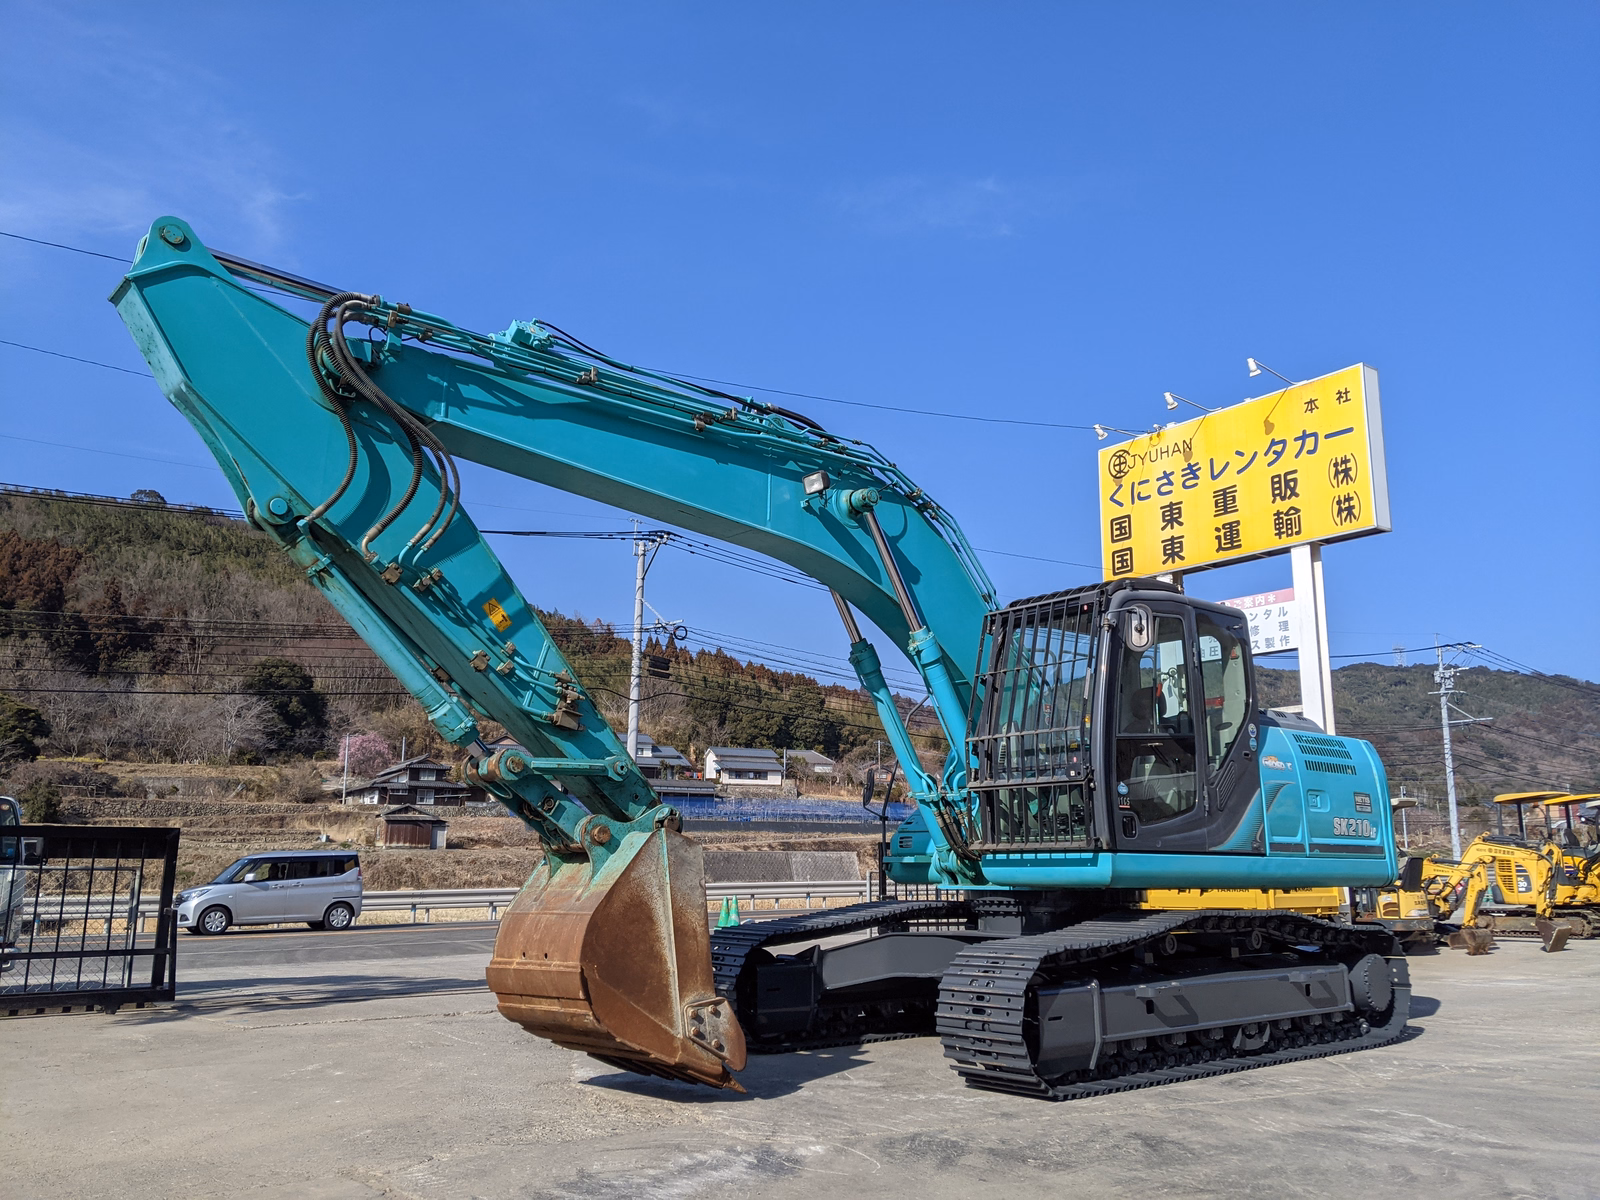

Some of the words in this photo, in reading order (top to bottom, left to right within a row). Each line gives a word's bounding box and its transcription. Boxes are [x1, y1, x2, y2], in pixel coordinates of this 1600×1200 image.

[1304, 387, 1351, 414] 本社
[1109, 426, 1354, 507] くにさきレンタカー
[1128, 438, 1192, 470] JYUHAN
[1333, 817, 1370, 837] SK210
